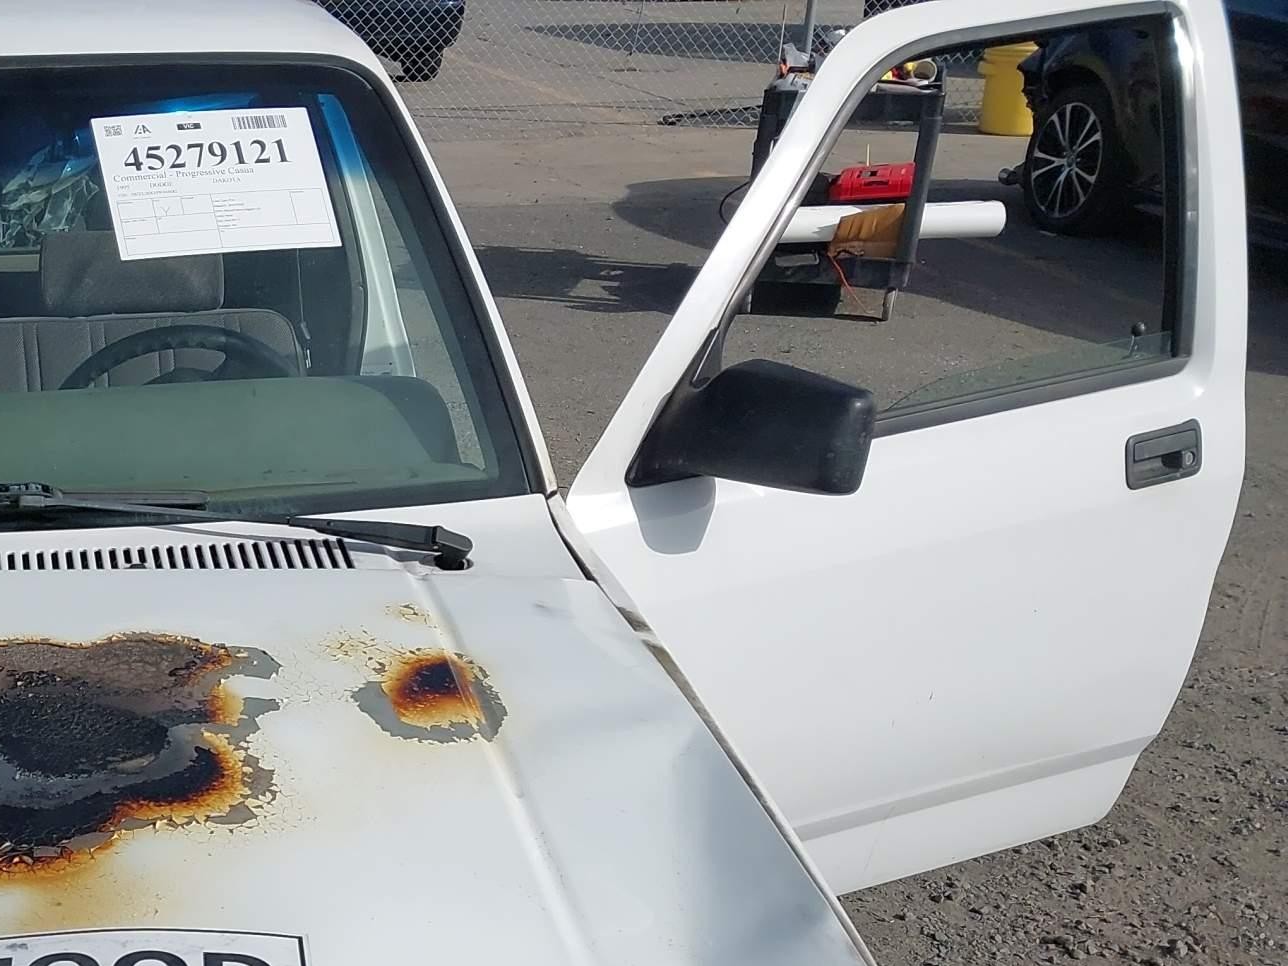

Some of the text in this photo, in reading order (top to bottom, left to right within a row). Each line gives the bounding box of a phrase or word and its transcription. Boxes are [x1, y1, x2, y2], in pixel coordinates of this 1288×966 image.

[124, 138, 293, 171] 45279121
[113, 171, 167, 183] Commercial
[175, 168, 226, 179] Progressive
